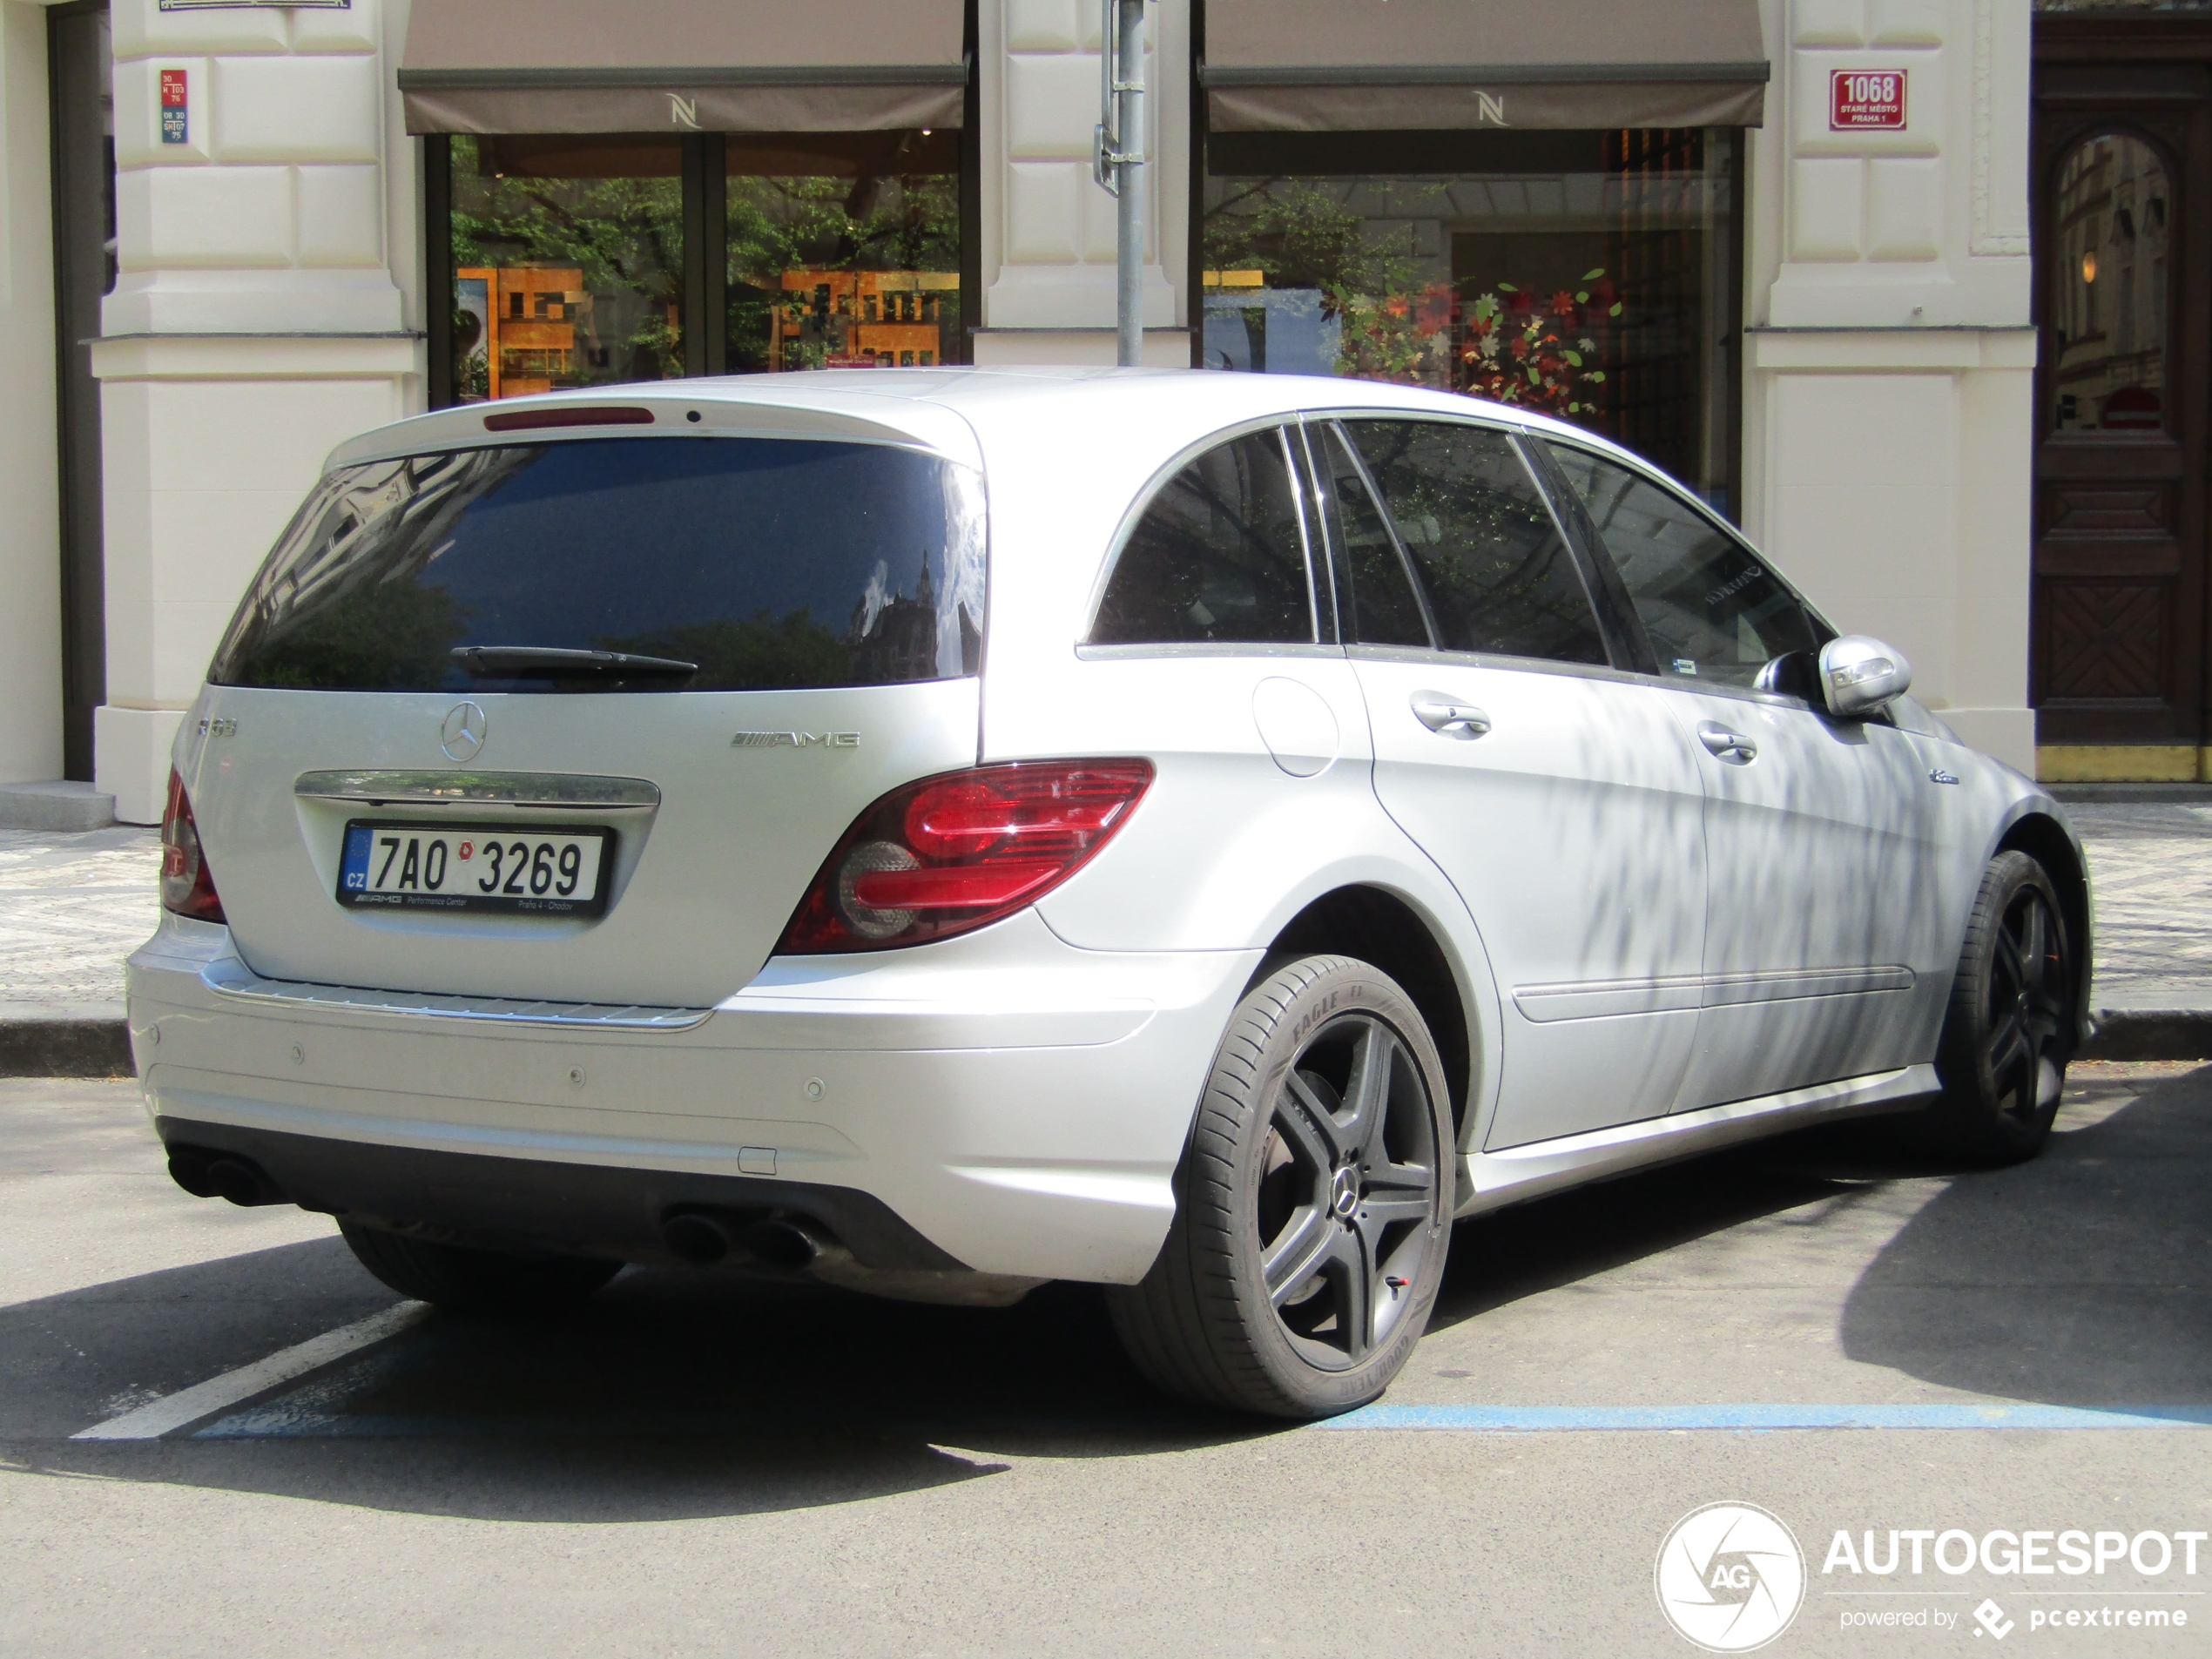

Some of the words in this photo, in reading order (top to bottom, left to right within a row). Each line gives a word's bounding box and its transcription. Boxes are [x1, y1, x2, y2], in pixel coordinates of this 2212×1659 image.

[1844, 76, 1895, 103] 1068
[1840, 104, 1868, 113] STARÉ
[1869, 104, 1898, 113] MĚSTO
[770, 731, 860, 748] AMG
[375, 837, 448, 891] 7A0
[479, 840, 582, 896] 3269
[347, 872, 366, 888] CZ
[408, 896, 445, 906] Performance
[446, 897, 468, 907] Center
[517, 900, 536, 909] Praha
[1292, 990, 1339, 1046] EAGLE
